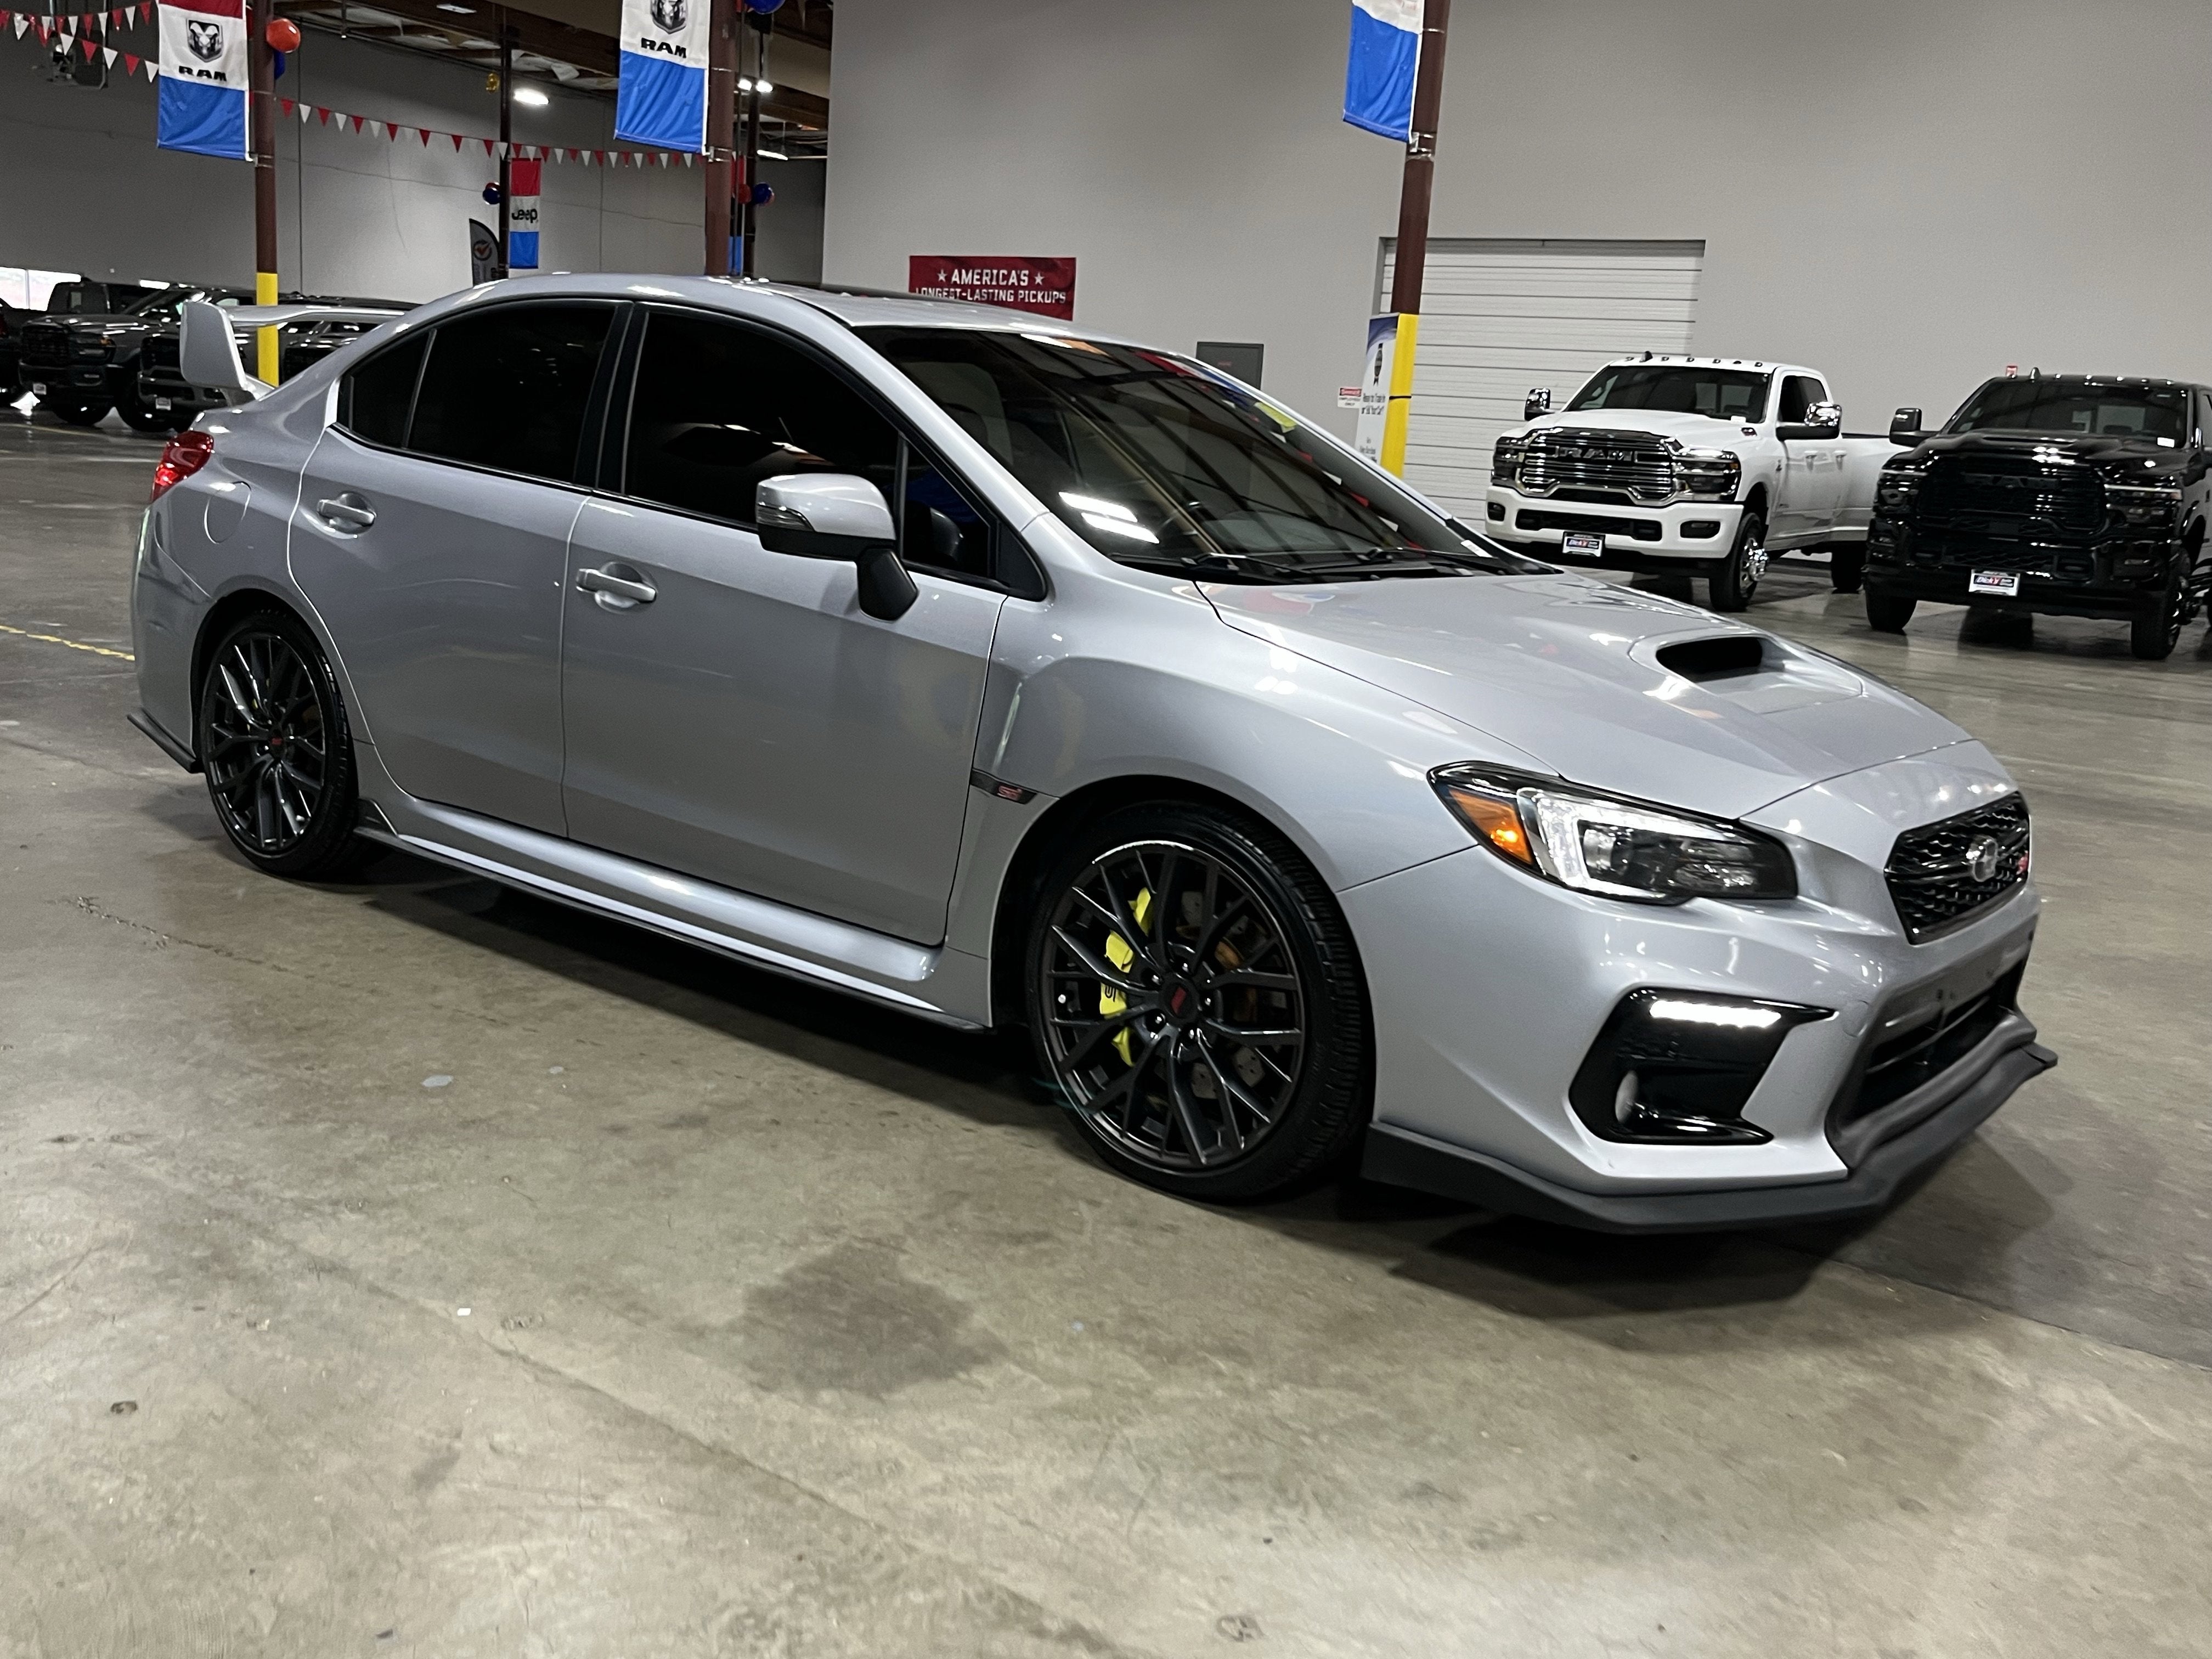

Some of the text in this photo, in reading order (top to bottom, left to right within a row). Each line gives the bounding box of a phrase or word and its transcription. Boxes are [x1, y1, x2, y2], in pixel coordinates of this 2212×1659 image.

[641, 37, 687, 59] RAM
[178, 65, 227, 82] RAM
[511, 208, 538, 224] Jeep
[950, 269, 1030, 286] AMERICA'S
[1017, 290, 1066, 304] PICKUPS
[1559, 447, 1633, 462] RAM
